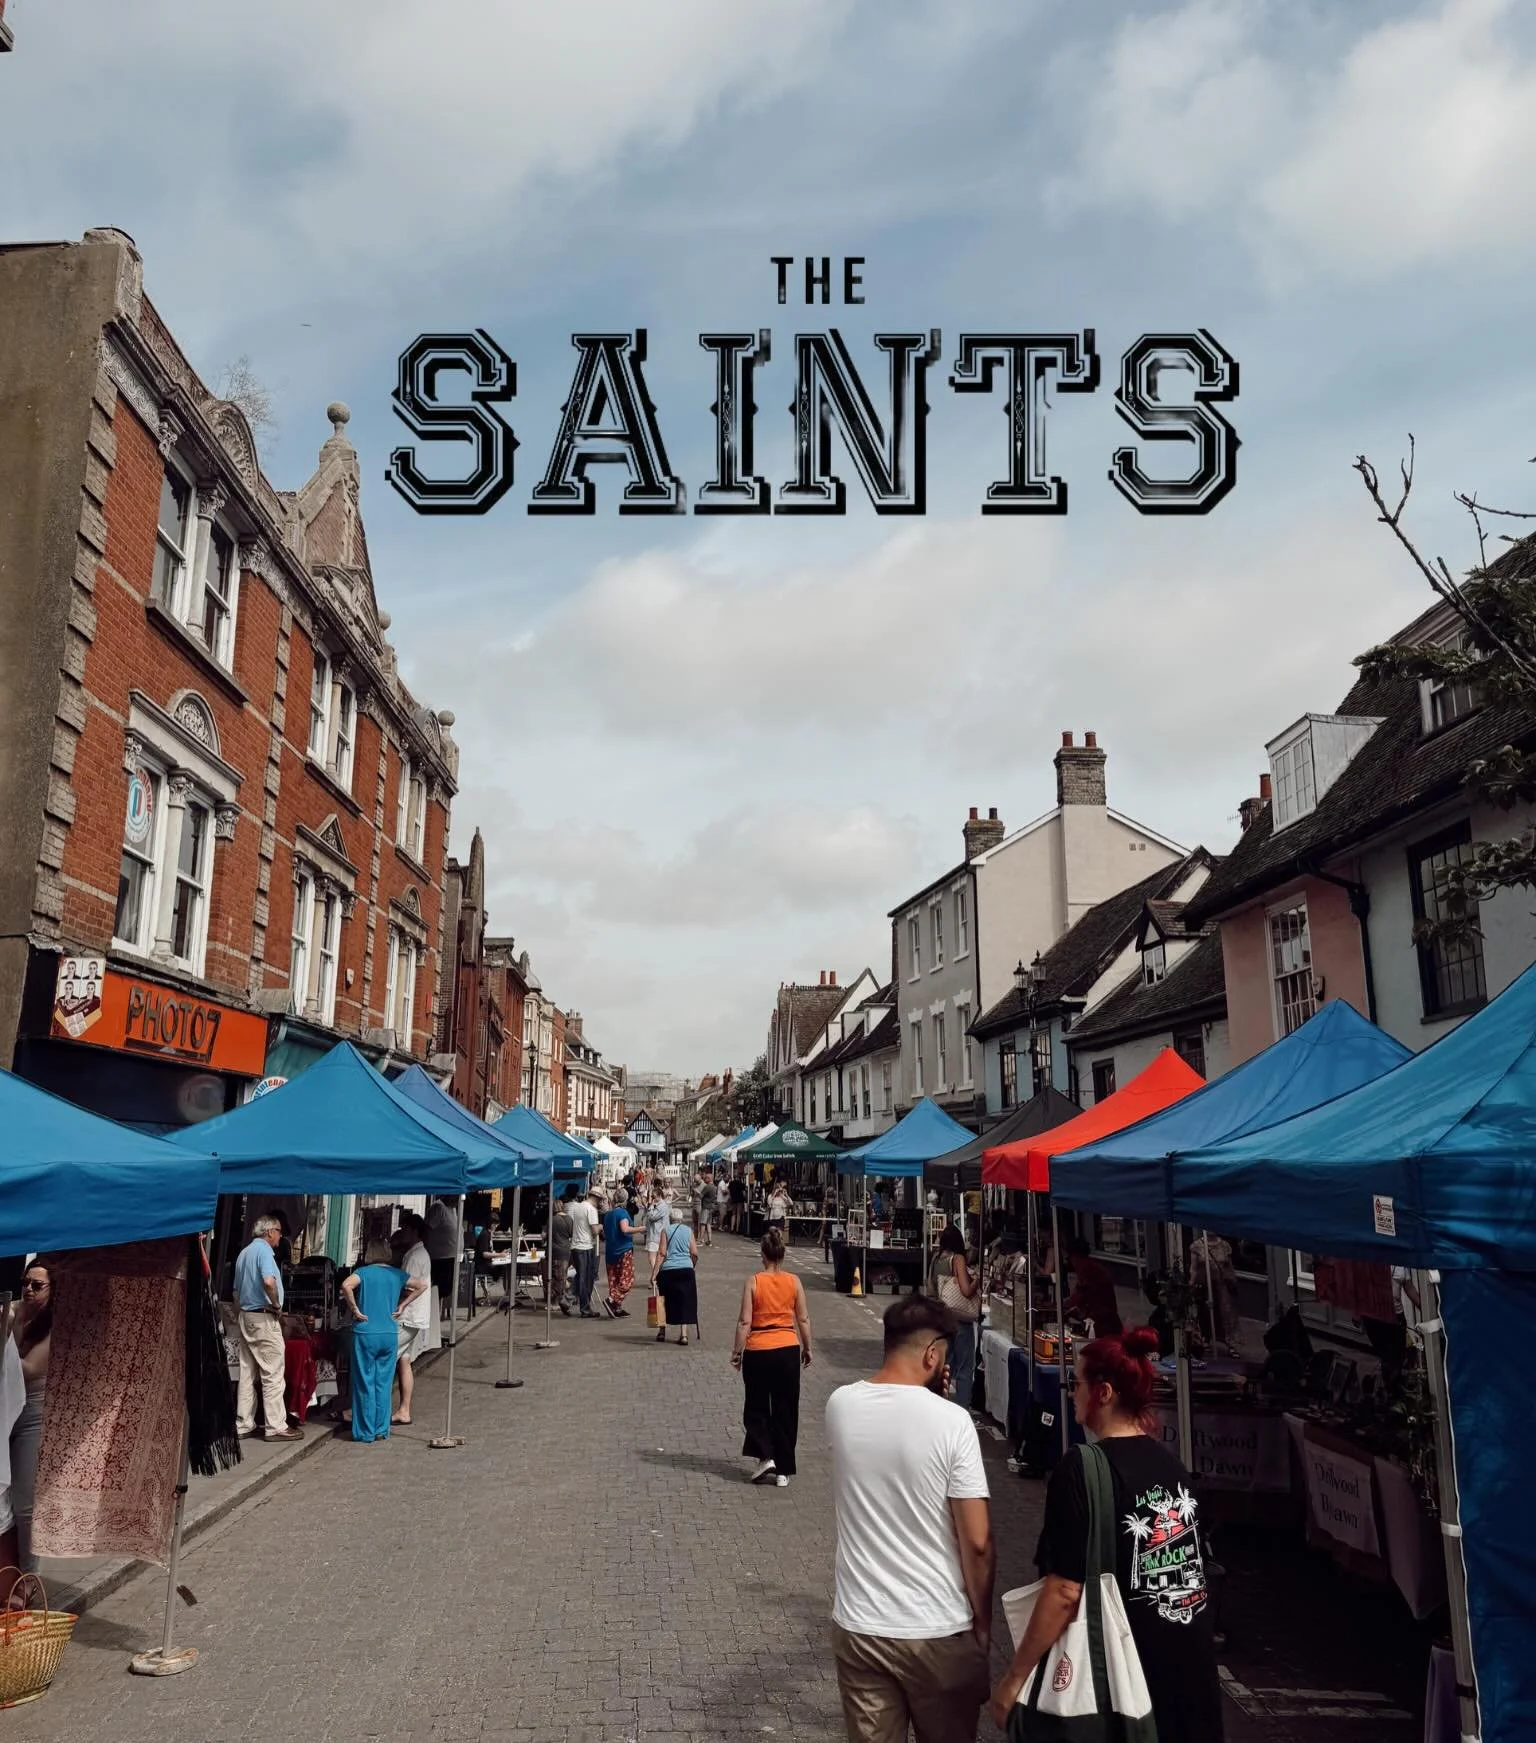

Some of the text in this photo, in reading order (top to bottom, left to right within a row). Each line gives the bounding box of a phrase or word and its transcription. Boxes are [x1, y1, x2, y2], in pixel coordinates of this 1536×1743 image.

[1163, 1425, 1257, 1450] Dftwood
[1200, 1456, 1254, 1475] Dawn
[1161, 1546, 1187, 1567] ROCK
